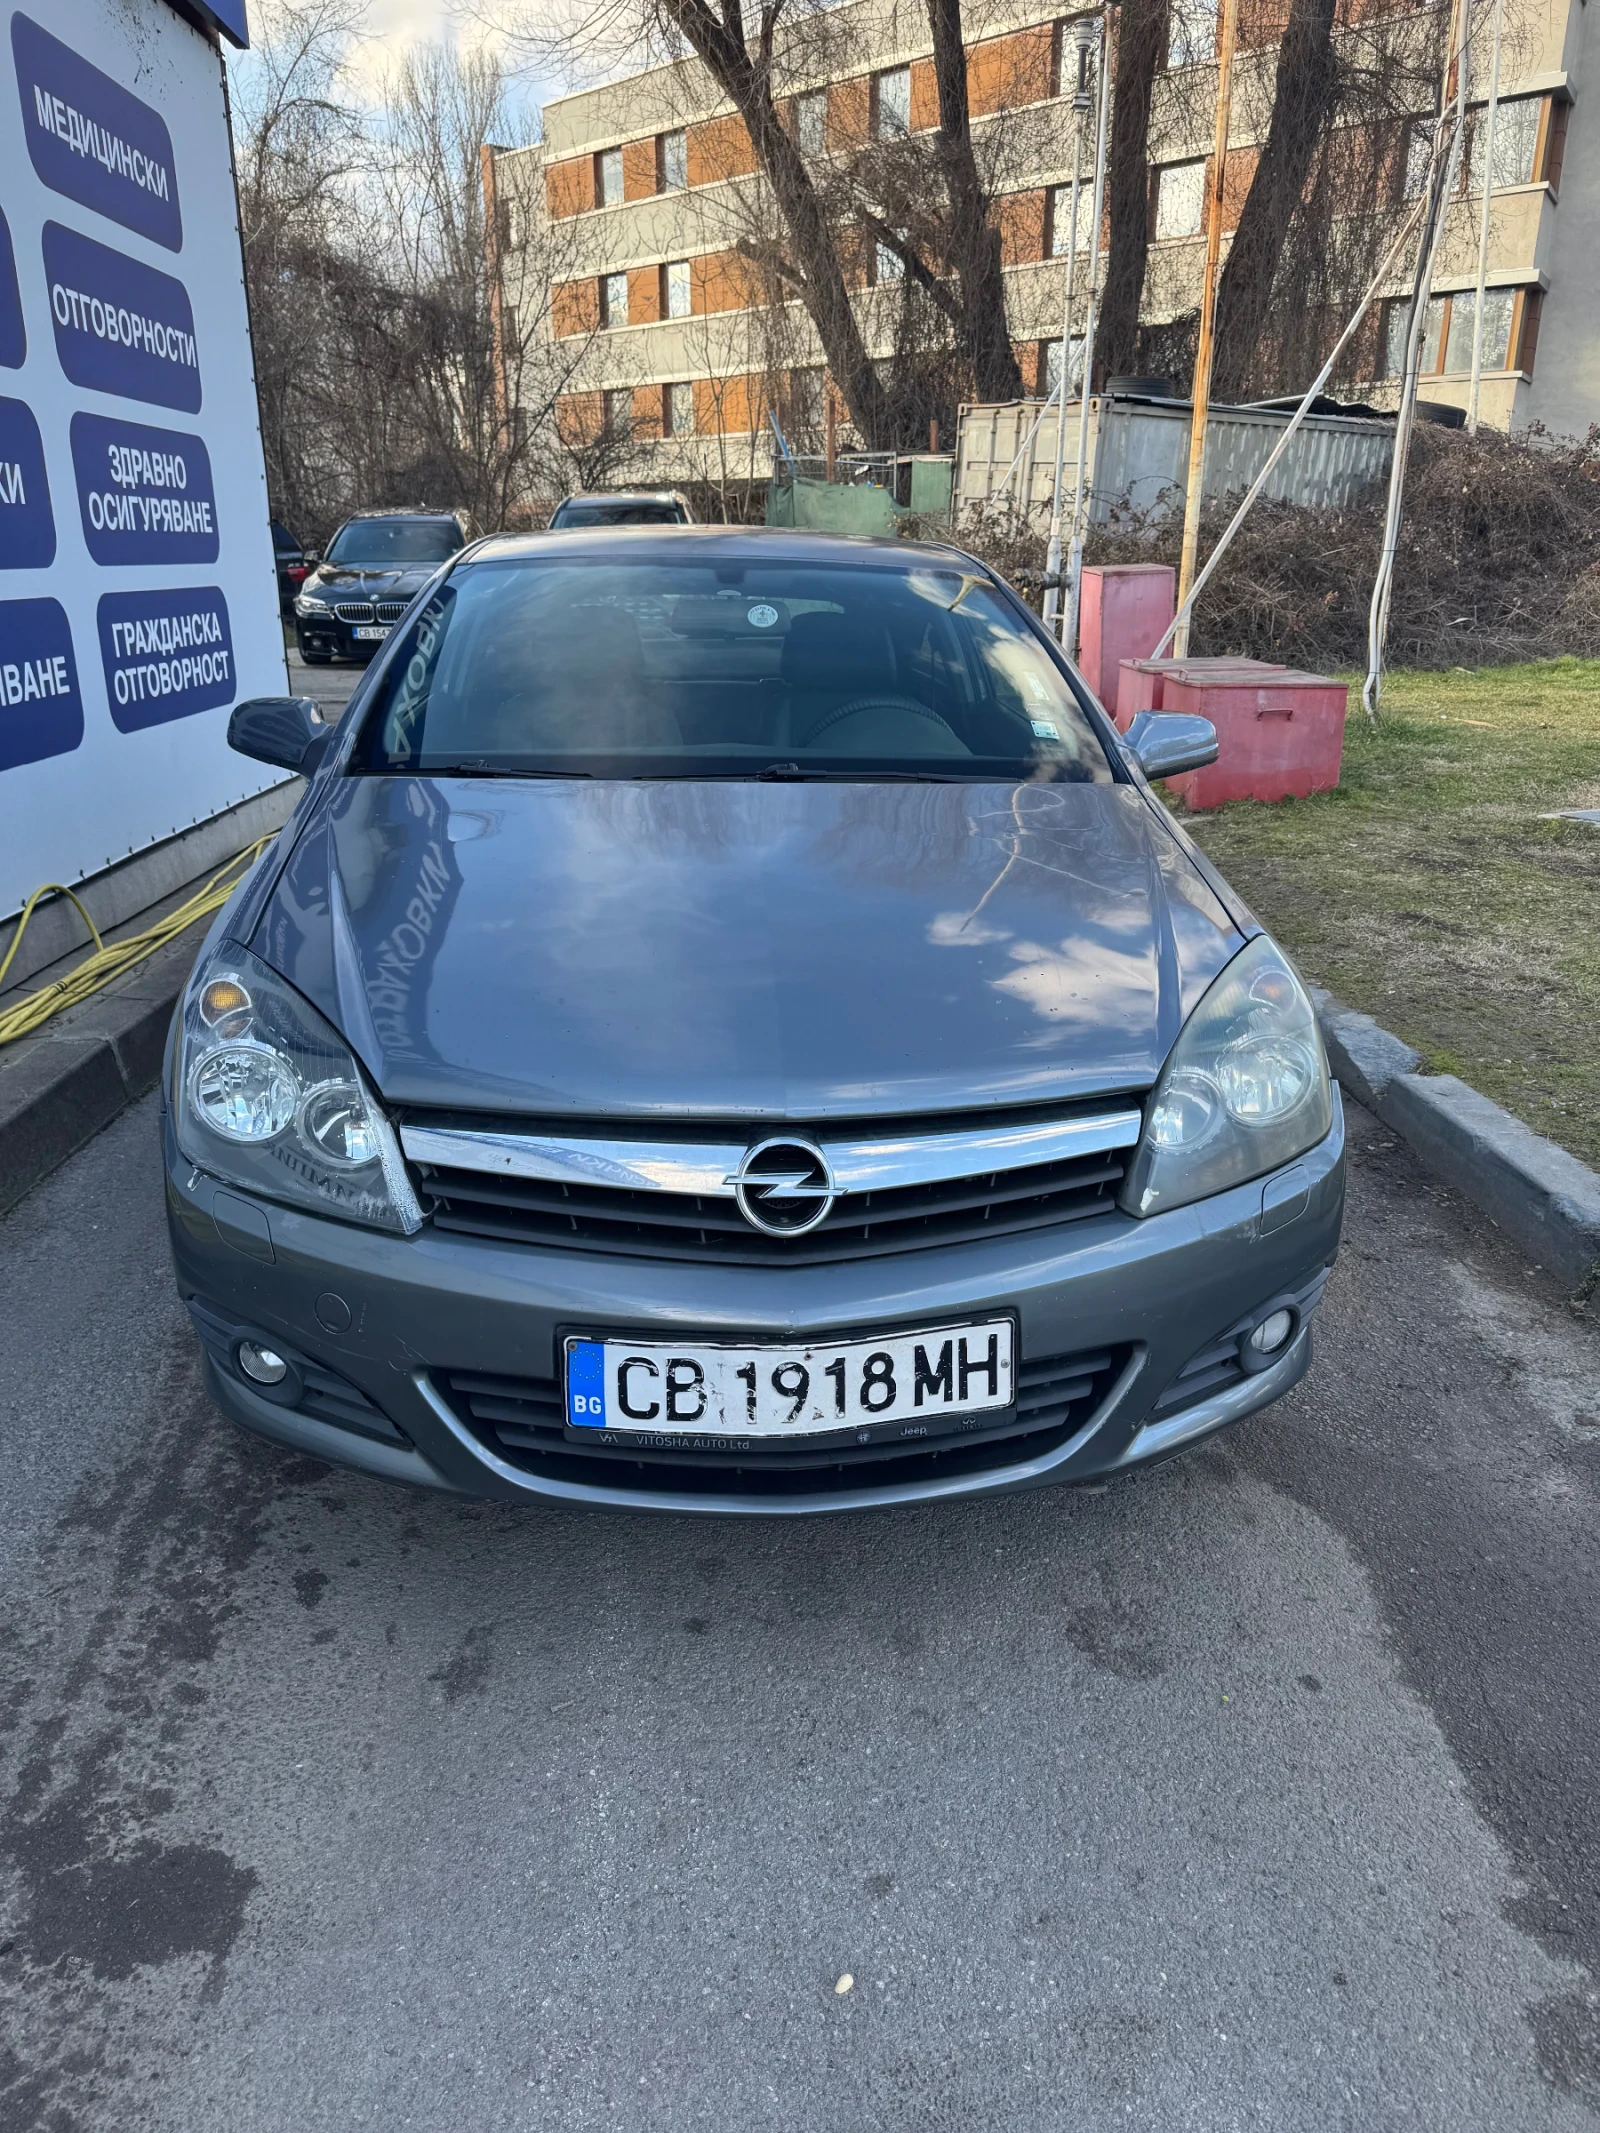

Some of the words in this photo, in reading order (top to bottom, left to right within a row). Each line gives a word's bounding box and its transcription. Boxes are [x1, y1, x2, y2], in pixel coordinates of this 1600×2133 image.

[33, 84, 169, 202] МЕДИЦИНСКИ
[52, 283, 197, 368] ОТГОВОРНОСТИ
[108, 444, 187, 490] ЗДРАВНО
[88, 491, 213, 534] ОСИГУРЯВАНЕ
[111, 612, 222, 658] ГРАЖДАНСКА
[114, 650, 229, 705] ОТГОВОРНОСТ
[574, 1394, 602, 1414] BG
[735, 1350, 898, 1425] 1918
[636, 1435, 689, 1447] VITOSHA
[693, 1438, 727, 1449] AUTO
[900, 1426, 927, 1436] Jeep
